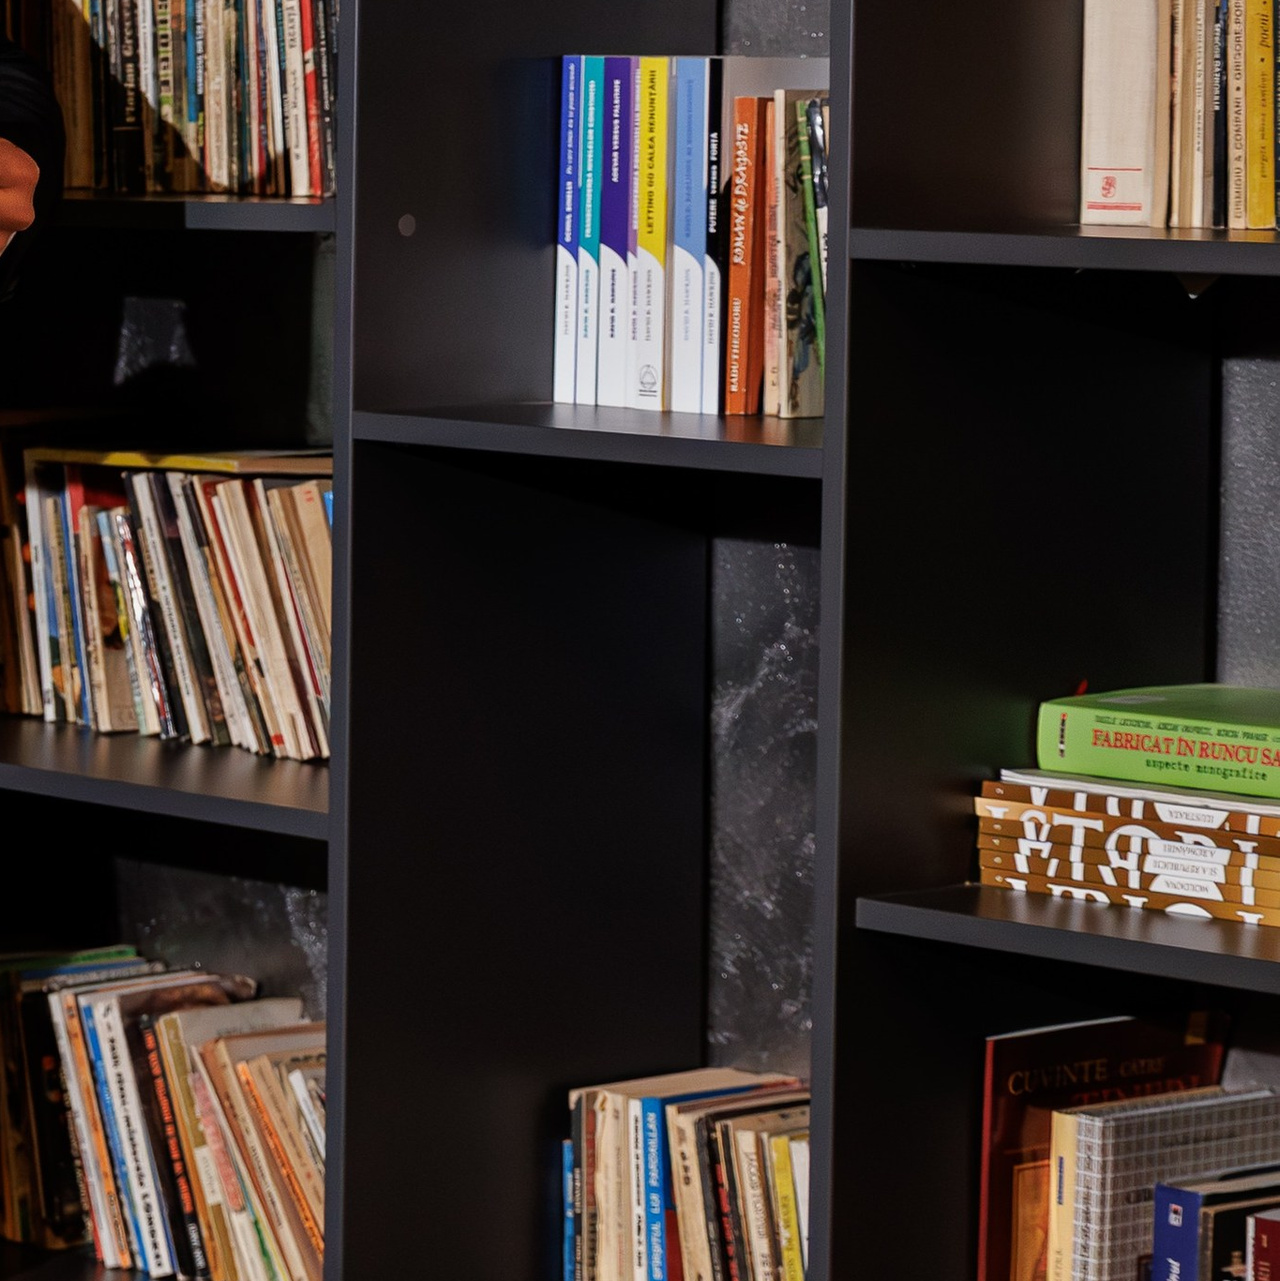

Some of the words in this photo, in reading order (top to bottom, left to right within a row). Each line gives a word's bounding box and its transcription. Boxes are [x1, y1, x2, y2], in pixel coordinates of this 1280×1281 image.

[646, 135, 657, 170] CALEA
[733, 123, 752, 197] DRAGOSTE
[707, 198, 718, 234] PUTERE
[1091, 728, 1175, 756] FABRICAT
[1198, 740, 1259, 765] RUNCU
[1006, 1057, 1109, 1097] CUVINTE
